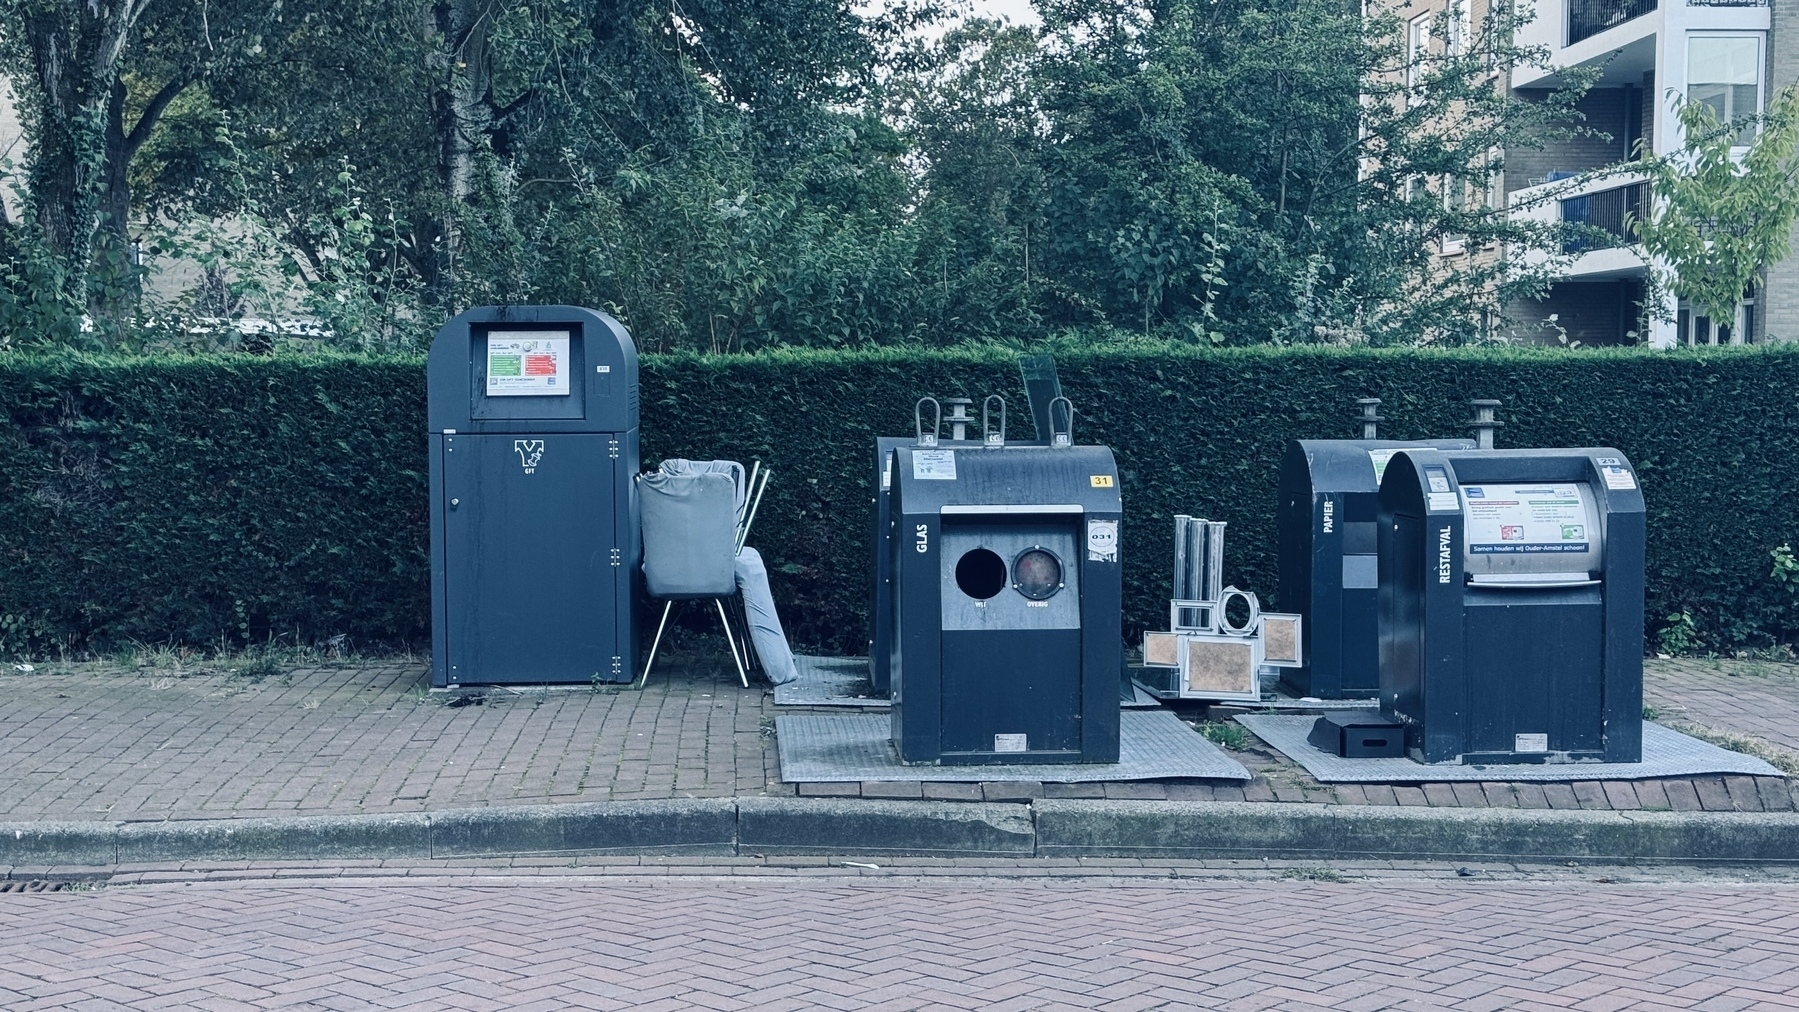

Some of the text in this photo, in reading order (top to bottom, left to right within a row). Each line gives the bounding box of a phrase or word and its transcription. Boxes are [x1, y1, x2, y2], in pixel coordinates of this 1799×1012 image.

[1094, 476, 1108, 485] 31
[1323, 500, 1333, 534] PAPIER
[916, 524, 928, 553] GLAS
[1439, 525, 1451, 584] RESTAFVAL
